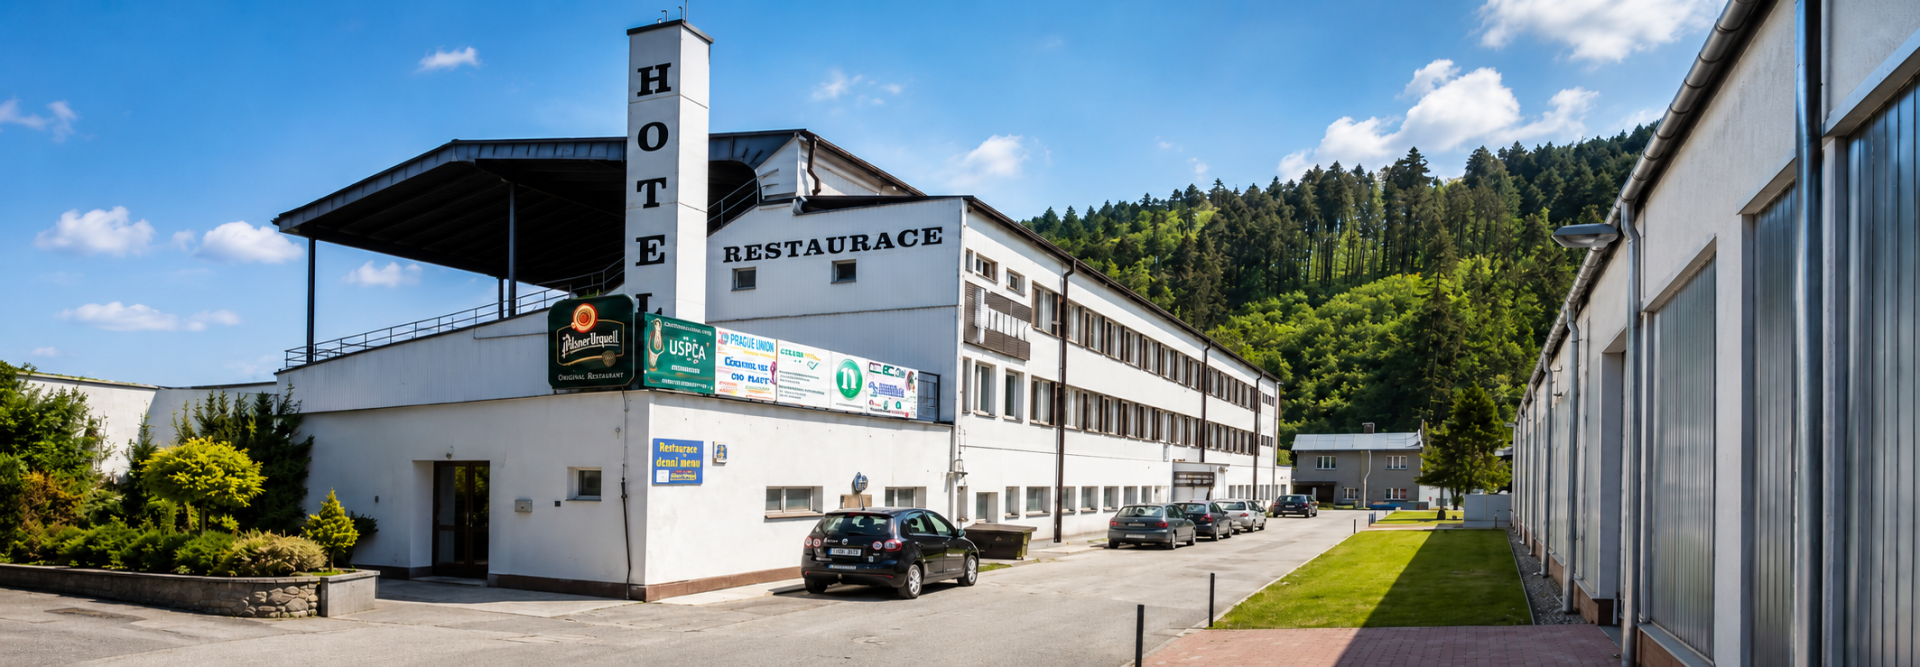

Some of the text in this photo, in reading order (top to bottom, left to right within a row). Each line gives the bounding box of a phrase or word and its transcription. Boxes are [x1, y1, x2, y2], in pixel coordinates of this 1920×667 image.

[722, 226, 943, 263] RESTAURACE
[561, 329, 619, 359] Pilsner Urquell
[730, 333, 755, 349] PRAGUE
[587, 371, 624, 380] RESTAURANT
[659, 441, 698, 454] Restaurace
[680, 459, 701, 468] menu
